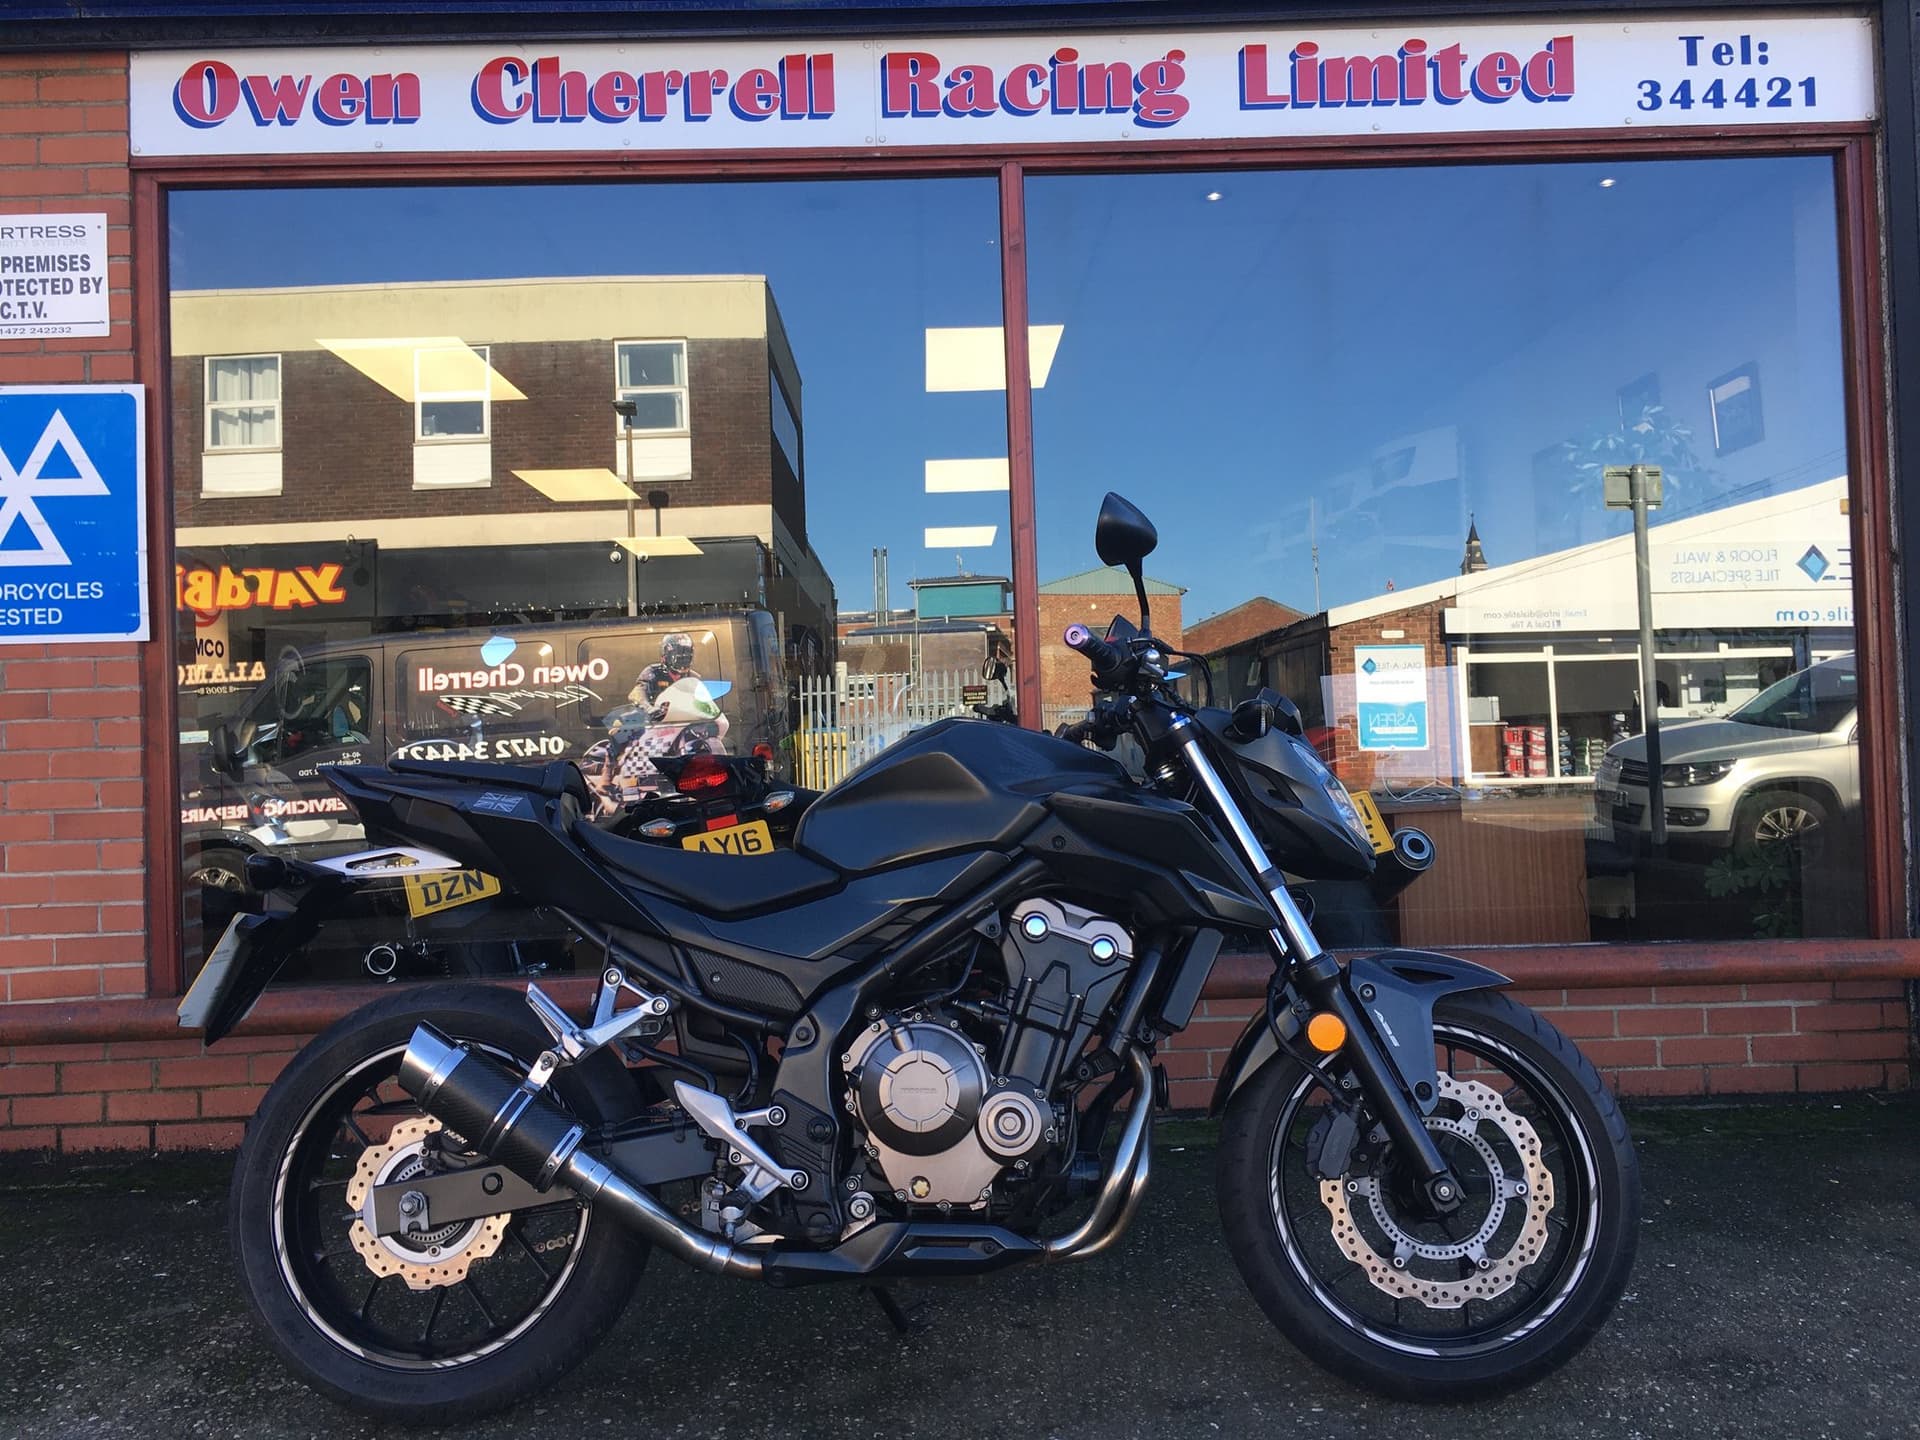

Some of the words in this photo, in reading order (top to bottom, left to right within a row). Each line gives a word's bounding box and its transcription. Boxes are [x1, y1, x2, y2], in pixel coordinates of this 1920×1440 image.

[1678, 35, 1769, 67] Tel:
[172, 60, 420, 129] Owen
[470, 53, 836, 125] Cherrell
[880, 47, 1190, 128] Racing
[1238, 35, 1576, 111] Limited
[1636, 76, 1817, 111] 344421
[1, 254, 91, 273] PREMISES
[0, 277, 74, 296] TECTED
[79, 276, 103, 294] BY
[30, 326, 72, 334] 242232
[0, 582, 104, 600] RCYCLES
